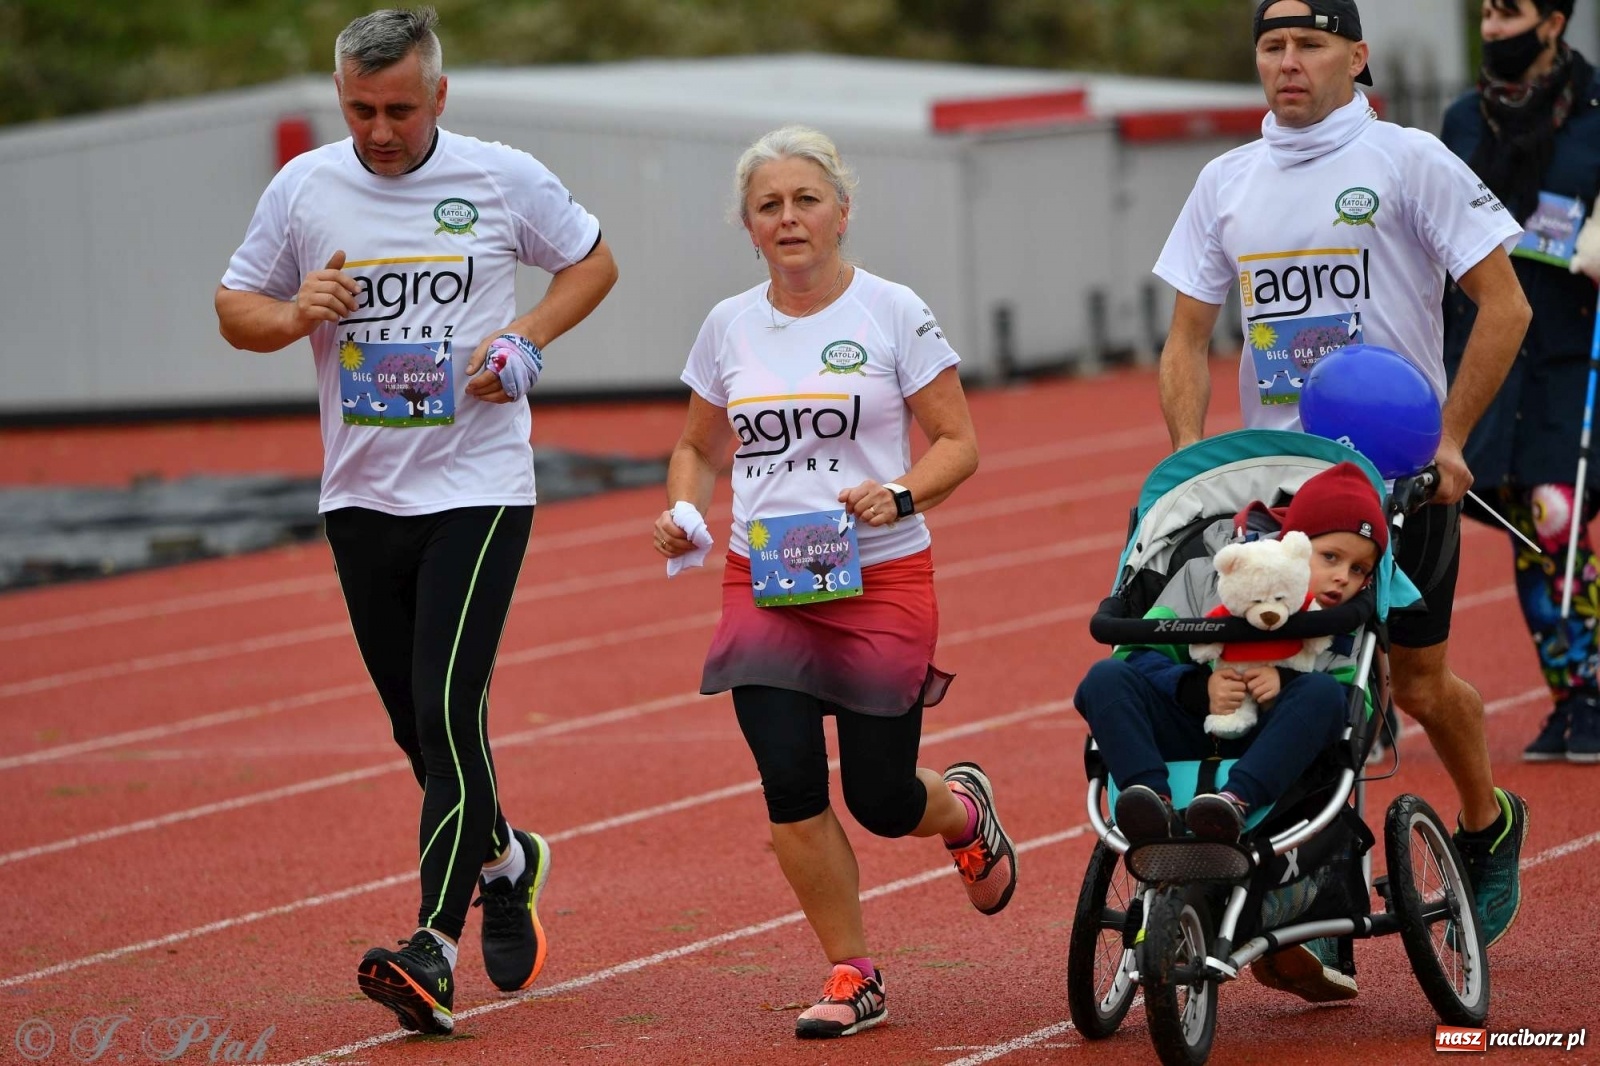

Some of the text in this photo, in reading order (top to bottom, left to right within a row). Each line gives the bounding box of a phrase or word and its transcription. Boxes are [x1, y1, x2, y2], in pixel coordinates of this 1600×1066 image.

[338, 256, 474, 325] agrol
[1247, 248, 1370, 321] agrol
[346, 325, 454, 342] KIETRZ
[1266, 349, 1289, 360] BIEG
[1294, 347, 1313, 359] DLA
[352, 371, 372, 381] BIEG
[378, 373, 397, 383] DLA
[733, 394, 861, 458] agrol
[746, 458, 839, 478] KIETRZ
[761, 549, 779, 561] BIEG
[783, 547, 802, 559] DLA
[812, 570, 851, 592] 280
[1153, 619, 1226, 632] X-lander
